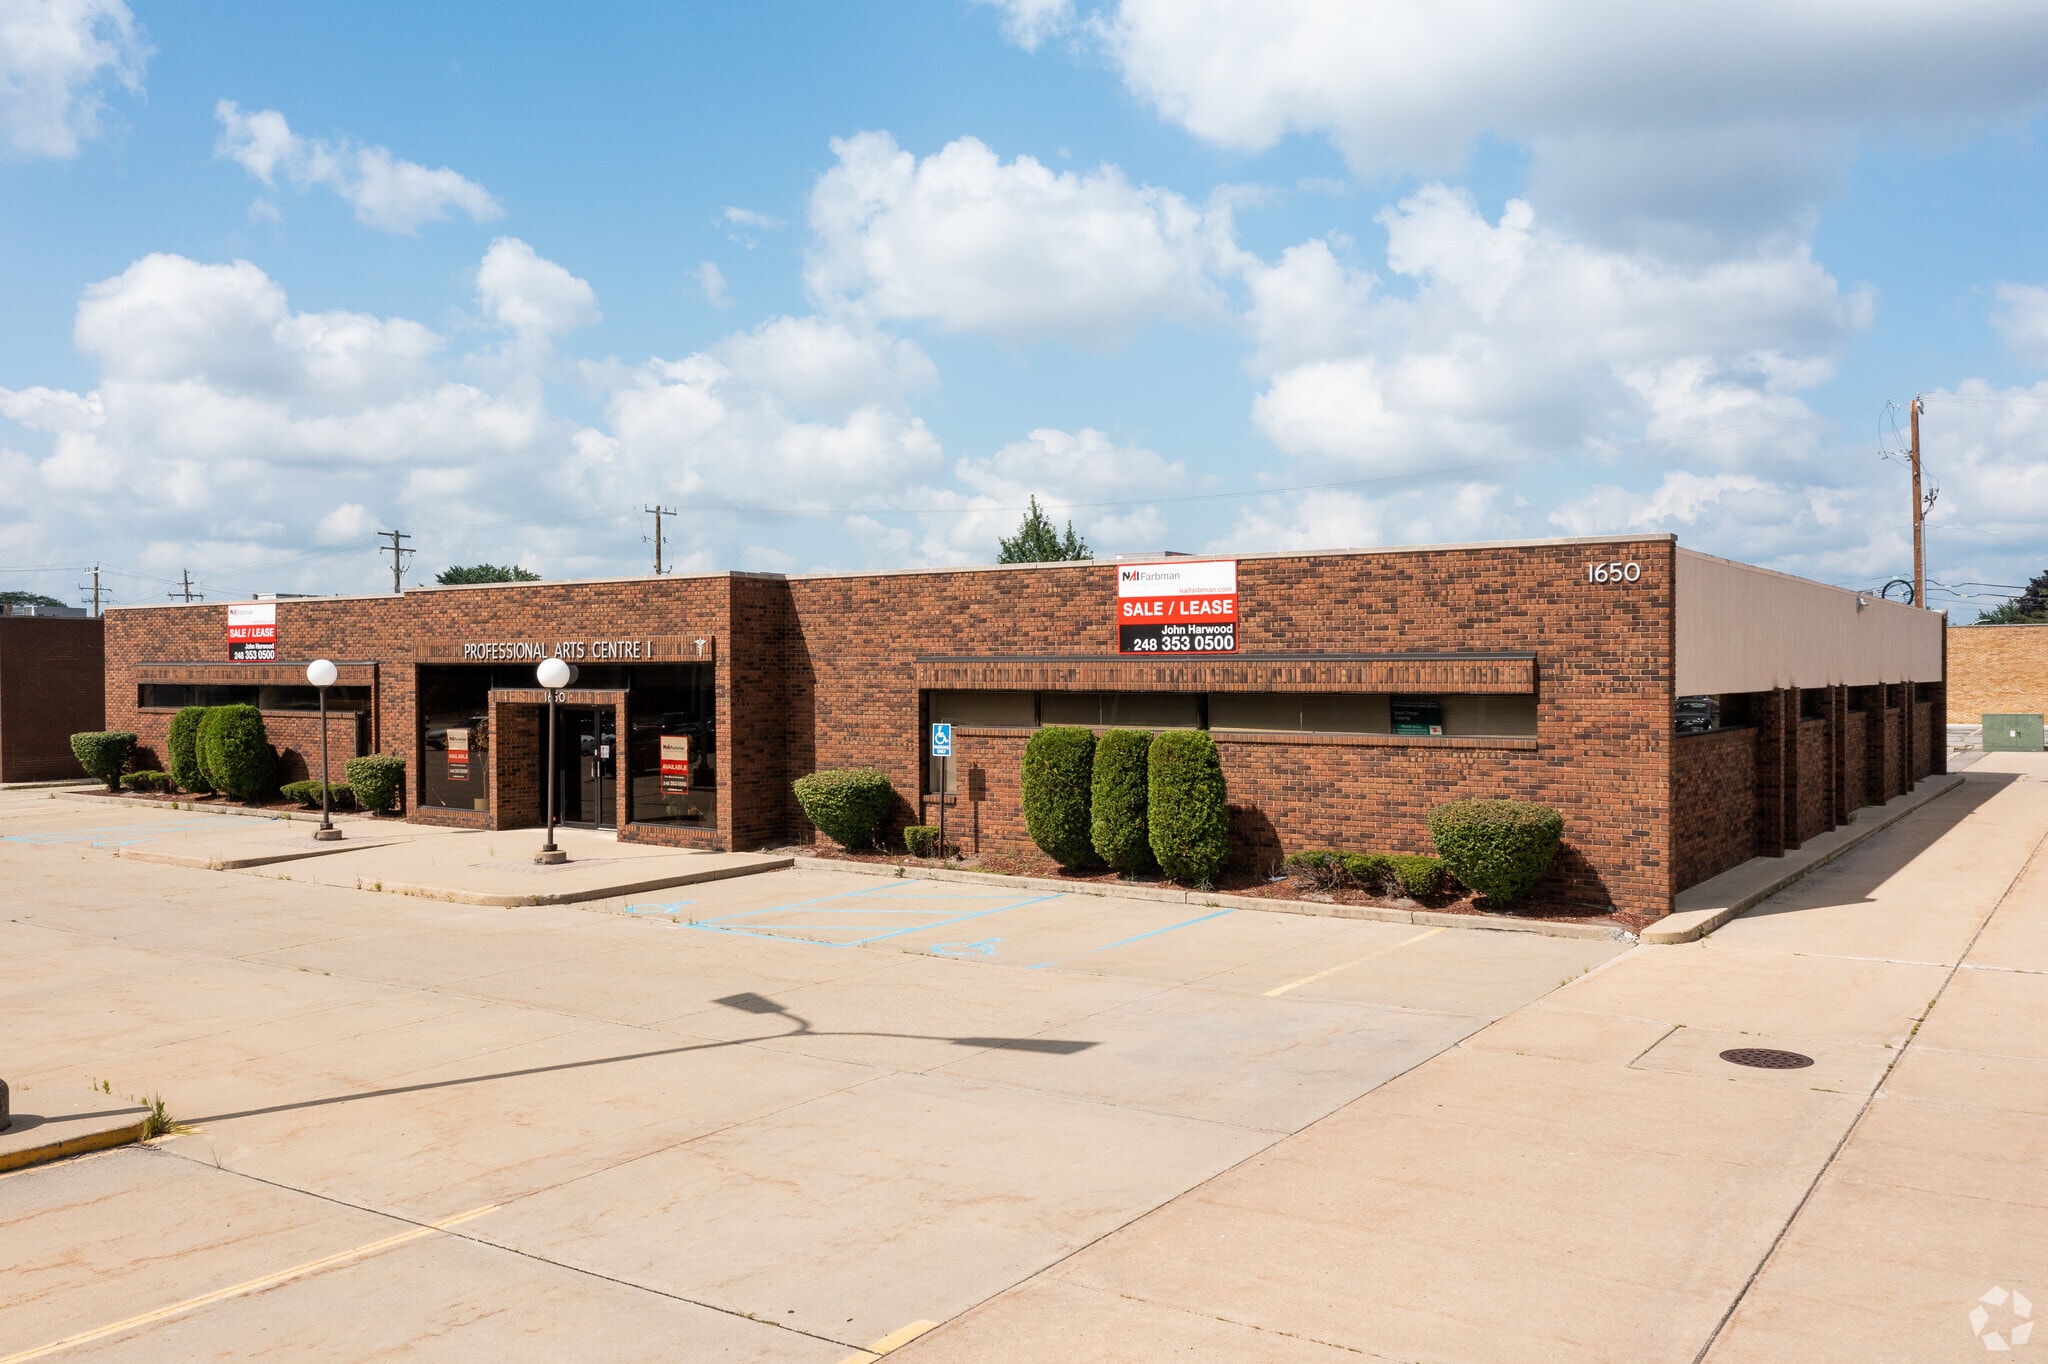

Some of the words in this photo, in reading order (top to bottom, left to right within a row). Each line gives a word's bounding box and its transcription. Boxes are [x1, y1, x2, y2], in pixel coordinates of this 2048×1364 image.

[1140, 572, 1180, 581] Farbman
[1588, 562, 1641, 583] 1650
[1179, 586, 1233, 594] naifarbman.com
[1123, 601, 1163, 617] SALE
[1168, 601, 1175, 616] /
[1180, 599, 1233, 616] LEASE
[230, 629, 246, 638] SALE
[252, 628, 274, 637] LEASE
[1161, 625, 1186, 635] John
[1188, 624, 1233, 635] Harwood
[1134, 638, 1158, 651] 248
[1161, 636, 1190, 651] 353
[1194, 635, 1234, 651] 0500
[234, 651, 244, 660] 248
[245, 650, 257, 660] 353
[258, 650, 274, 659] 0500
[464, 642, 548, 660] PROFESSIONAL
[554, 641, 585, 659] ARTS
[592, 640, 641, 659] CENTRE
[647, 640, 652, 658] I
